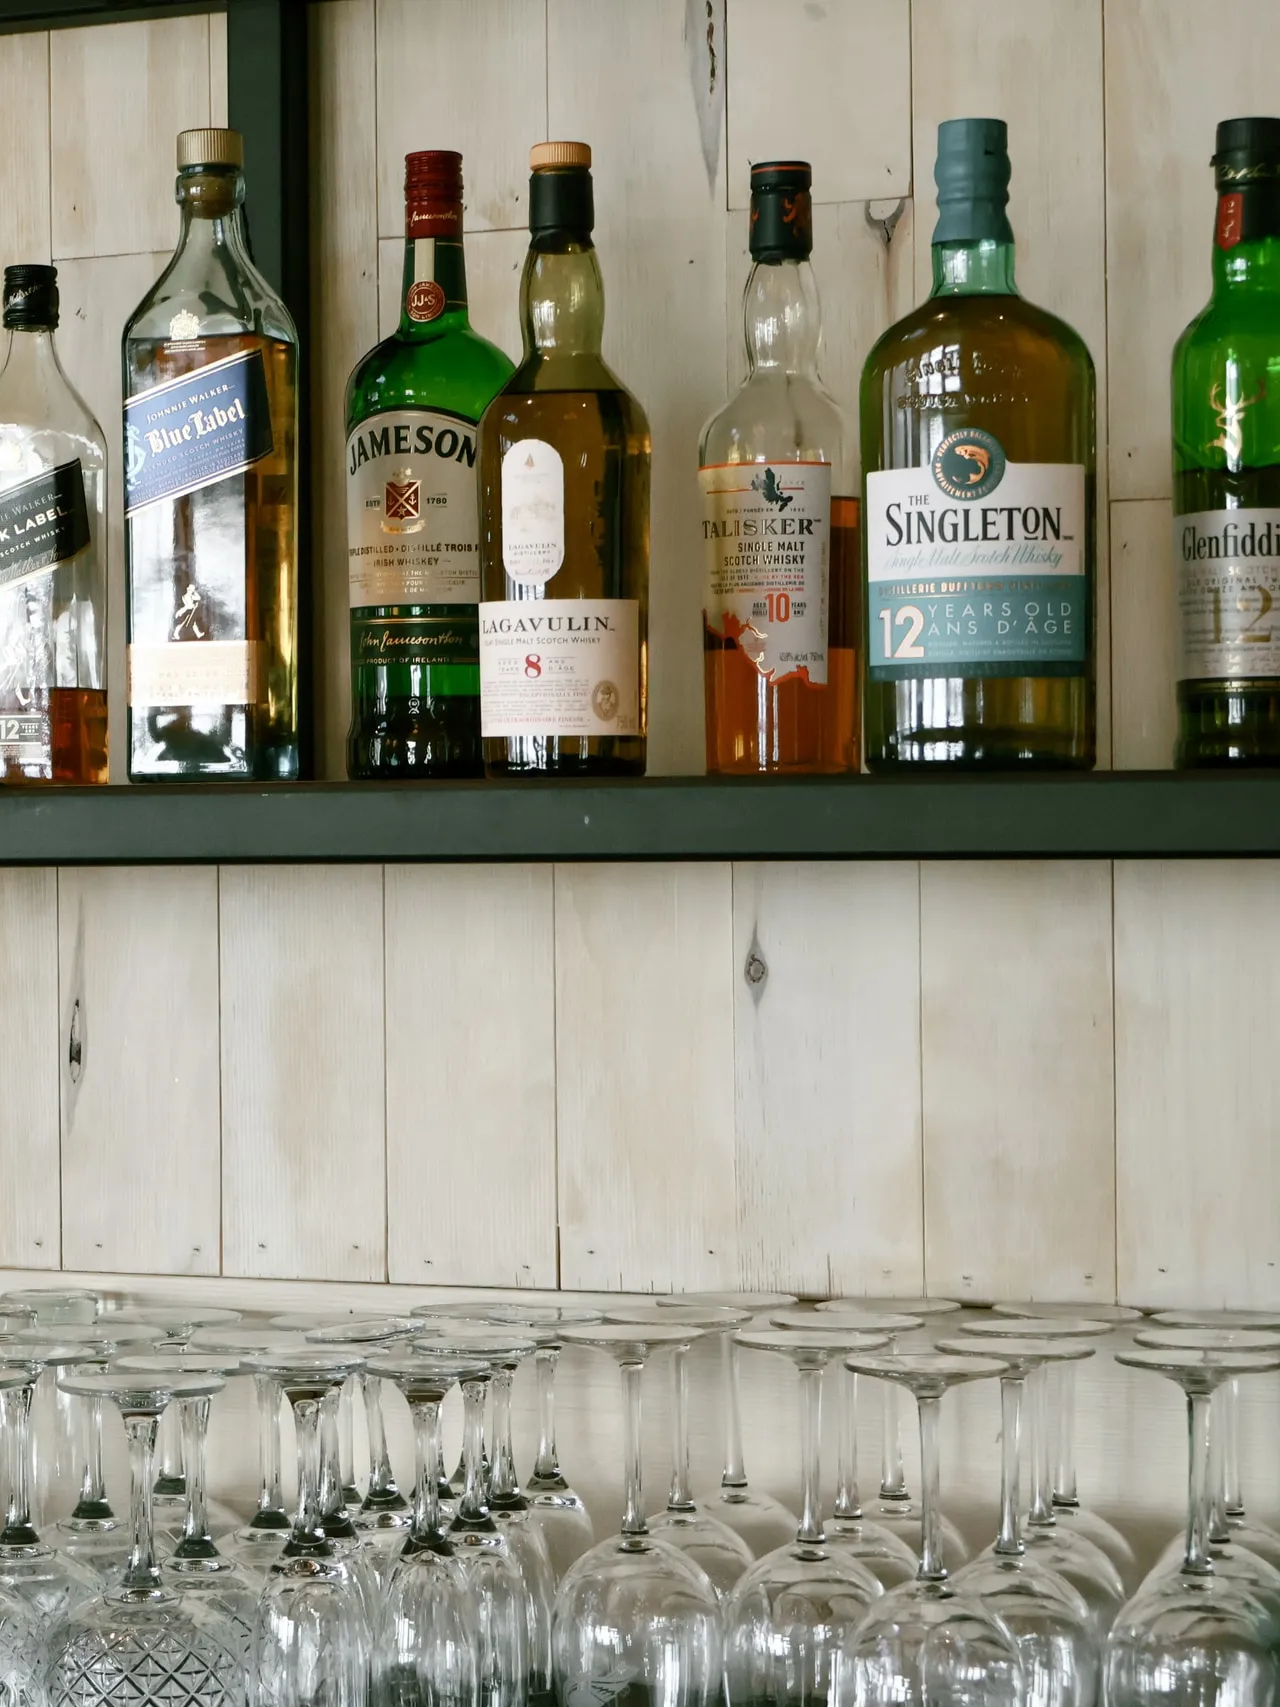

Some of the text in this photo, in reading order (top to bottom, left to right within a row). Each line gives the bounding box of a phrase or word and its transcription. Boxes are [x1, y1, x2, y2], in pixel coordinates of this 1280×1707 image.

[146, 384, 229, 425] JOHNNIE WALKER
[144, 398, 246, 458] Blue Label
[180, 441, 211, 458] SCOTCH
[212, 428, 244, 446] WHISKY
[350, 425, 477, 476] JAMESON
[937, 431, 968, 458] PERFECTLY
[12, 493, 54, 516] WALKER
[908, 495, 930, 505] THE
[13, 505, 68, 535] LABEL
[702, 519, 814, 539] TALISKER
[885, 502, 1061, 546] SINGLETON
[0, 540, 31, 558] SCOTCH
[444, 543, 472, 552] TROIS
[738, 541, 805, 552] SINGLE MALT
[959, 543, 1010, 567] Scotch
[1010, 543, 1063, 568] Whisky
[373, 557, 439, 567] IRISH WHISKEY
[724, 555, 805, 567] SCOTCH WHISKY
[940, 581, 1003, 593] DUFFTOWN
[765, 592, 791, 622] 10
[927, 602, 1071, 618] YEARS OLD
[1212, 586, 1273, 644] 12
[482, 617, 610, 634] LAGAVULIN
[879, 605, 925, 658] 12
[927, 618, 1072, 636] ANS D'ÂGE
[516, 637, 534, 645] MALT
[537, 637, 568, 645] SCOTCH
[571, 636, 601, 644] WHISKY
[524, 653, 542, 679] 8
